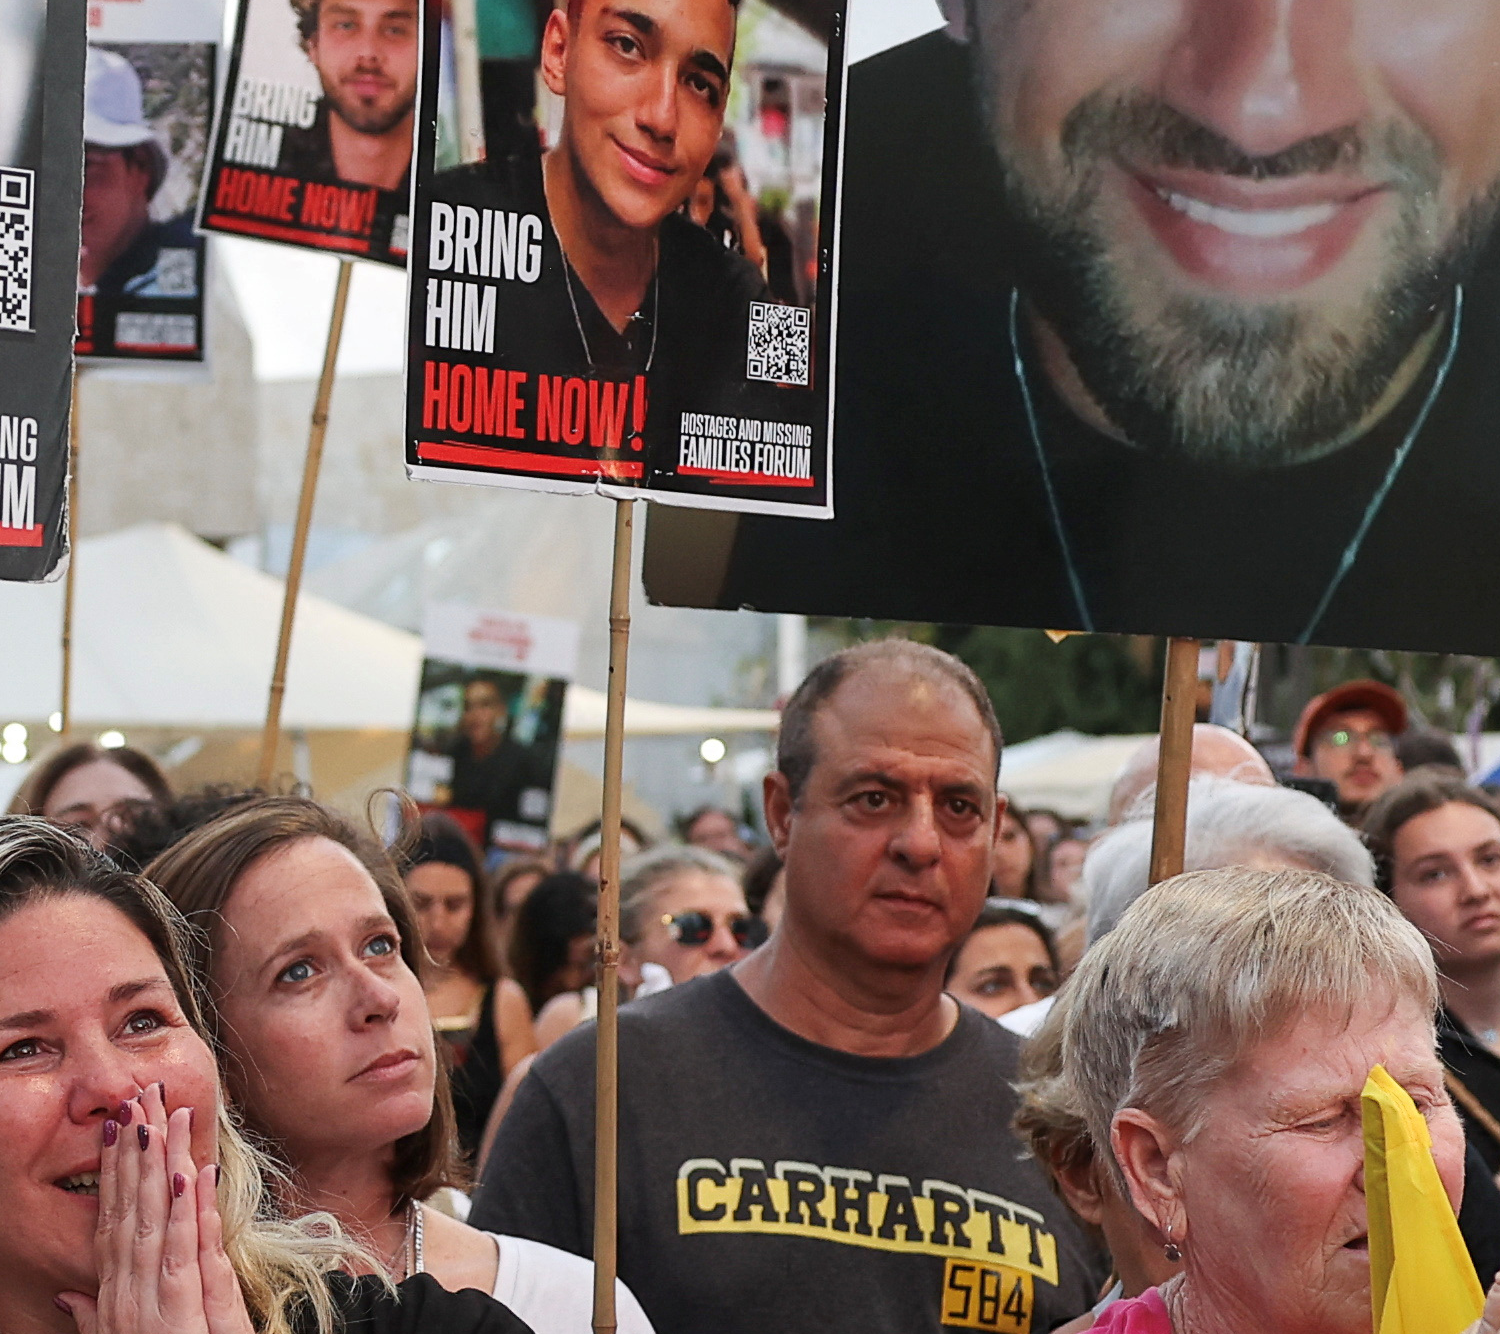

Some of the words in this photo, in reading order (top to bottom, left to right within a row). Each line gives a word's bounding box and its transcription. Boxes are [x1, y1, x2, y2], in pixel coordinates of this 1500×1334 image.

[234, 79, 318, 130] BRING
[223, 119, 284, 169] HIM
[214, 166, 300, 222] HOME
[300, 181, 379, 236] NOW!
[429, 201, 543, 283] BRING
[425, 278, 497, 354] HIM
[422, 360, 527, 440] HOME
[536, 374, 648, 452] NOW!
[681, 412, 737, 439] HOSTAGES
[738, 418, 762, 442] AND
[763, 421, 812, 447] MISSING
[679, 435, 751, 473] FAMILIES
[753, 443, 811, 480] FORUM
[678, 1158, 1058, 1272] CARHARTT
[946, 1264, 1028, 1327] 584
